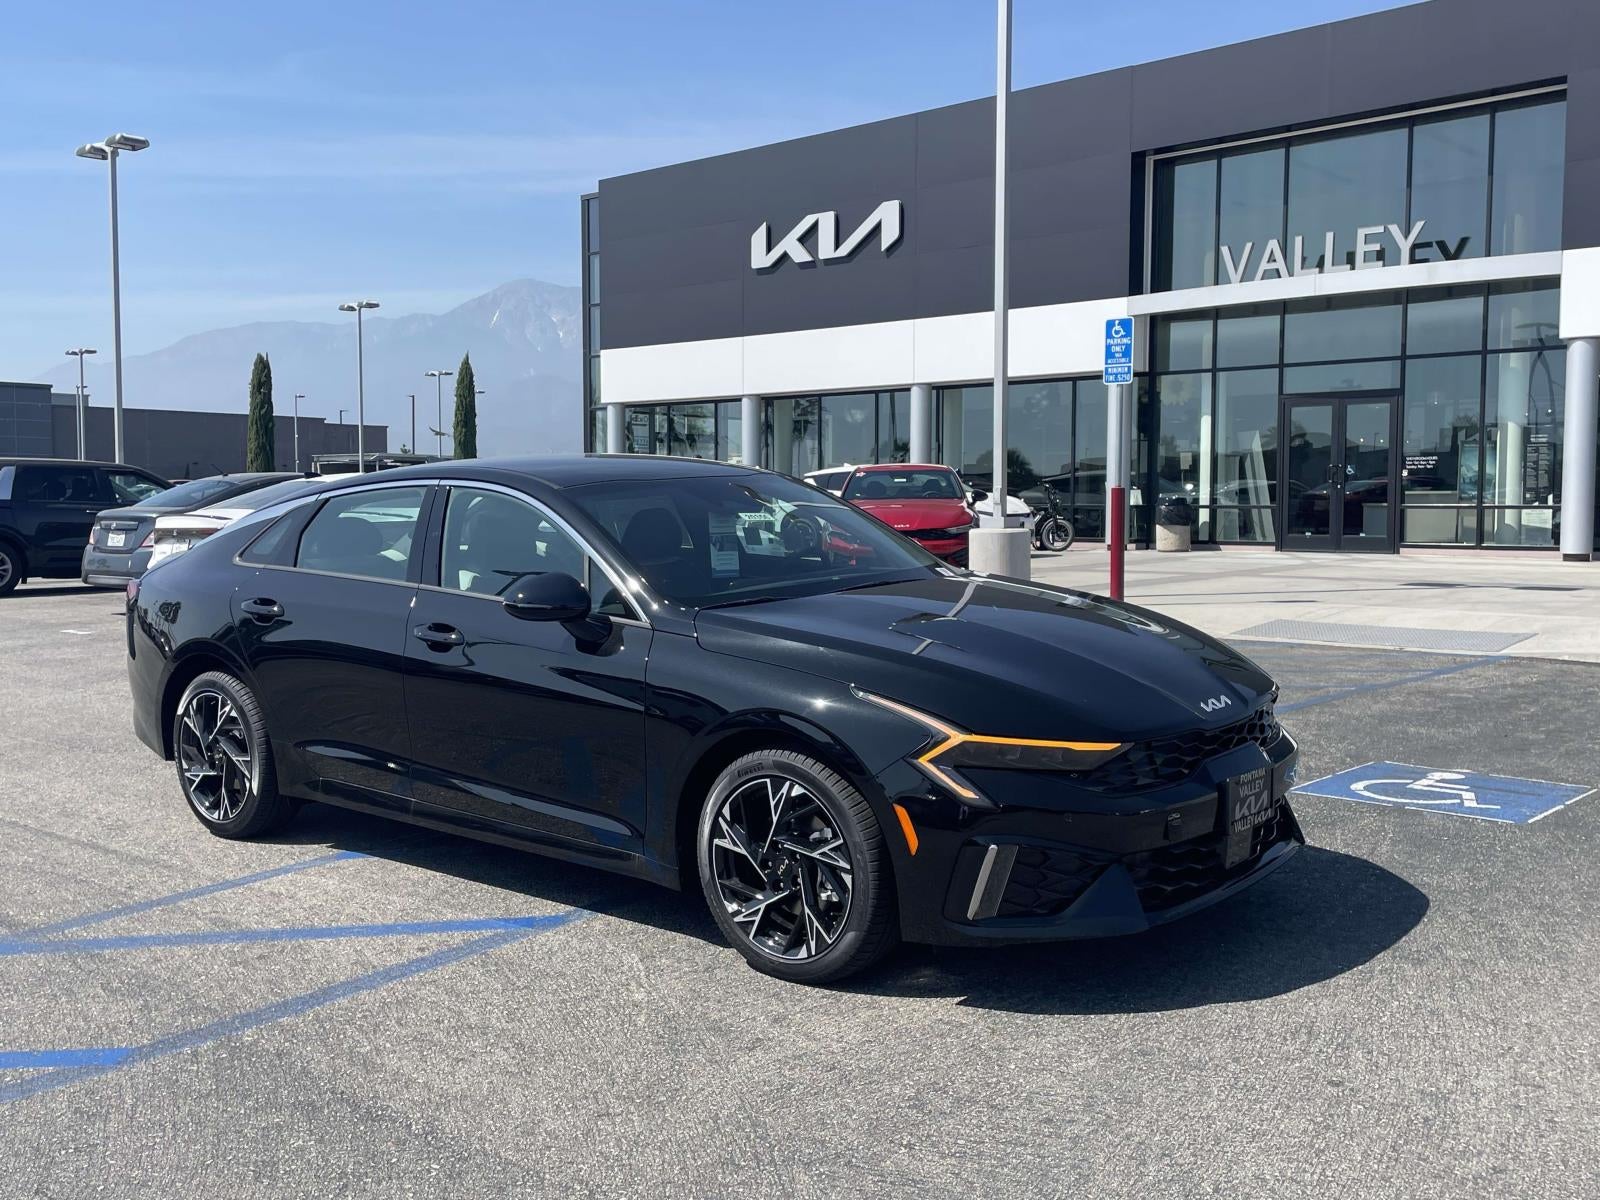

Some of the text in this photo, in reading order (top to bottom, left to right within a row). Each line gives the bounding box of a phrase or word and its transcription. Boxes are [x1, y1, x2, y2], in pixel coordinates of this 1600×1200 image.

[751, 199, 902, 269] KIA
[1220, 220, 1427, 284] VALLEY
[1106, 337, 1131, 346] PARKING
[1105, 374, 1131, 382] FINE $250
[1200, 695, 1232, 712] KIA
[1239, 778, 1265, 798] VALLEY
[1234, 790, 1268, 820] KIA
[1233, 814, 1254, 833] VALLEY
